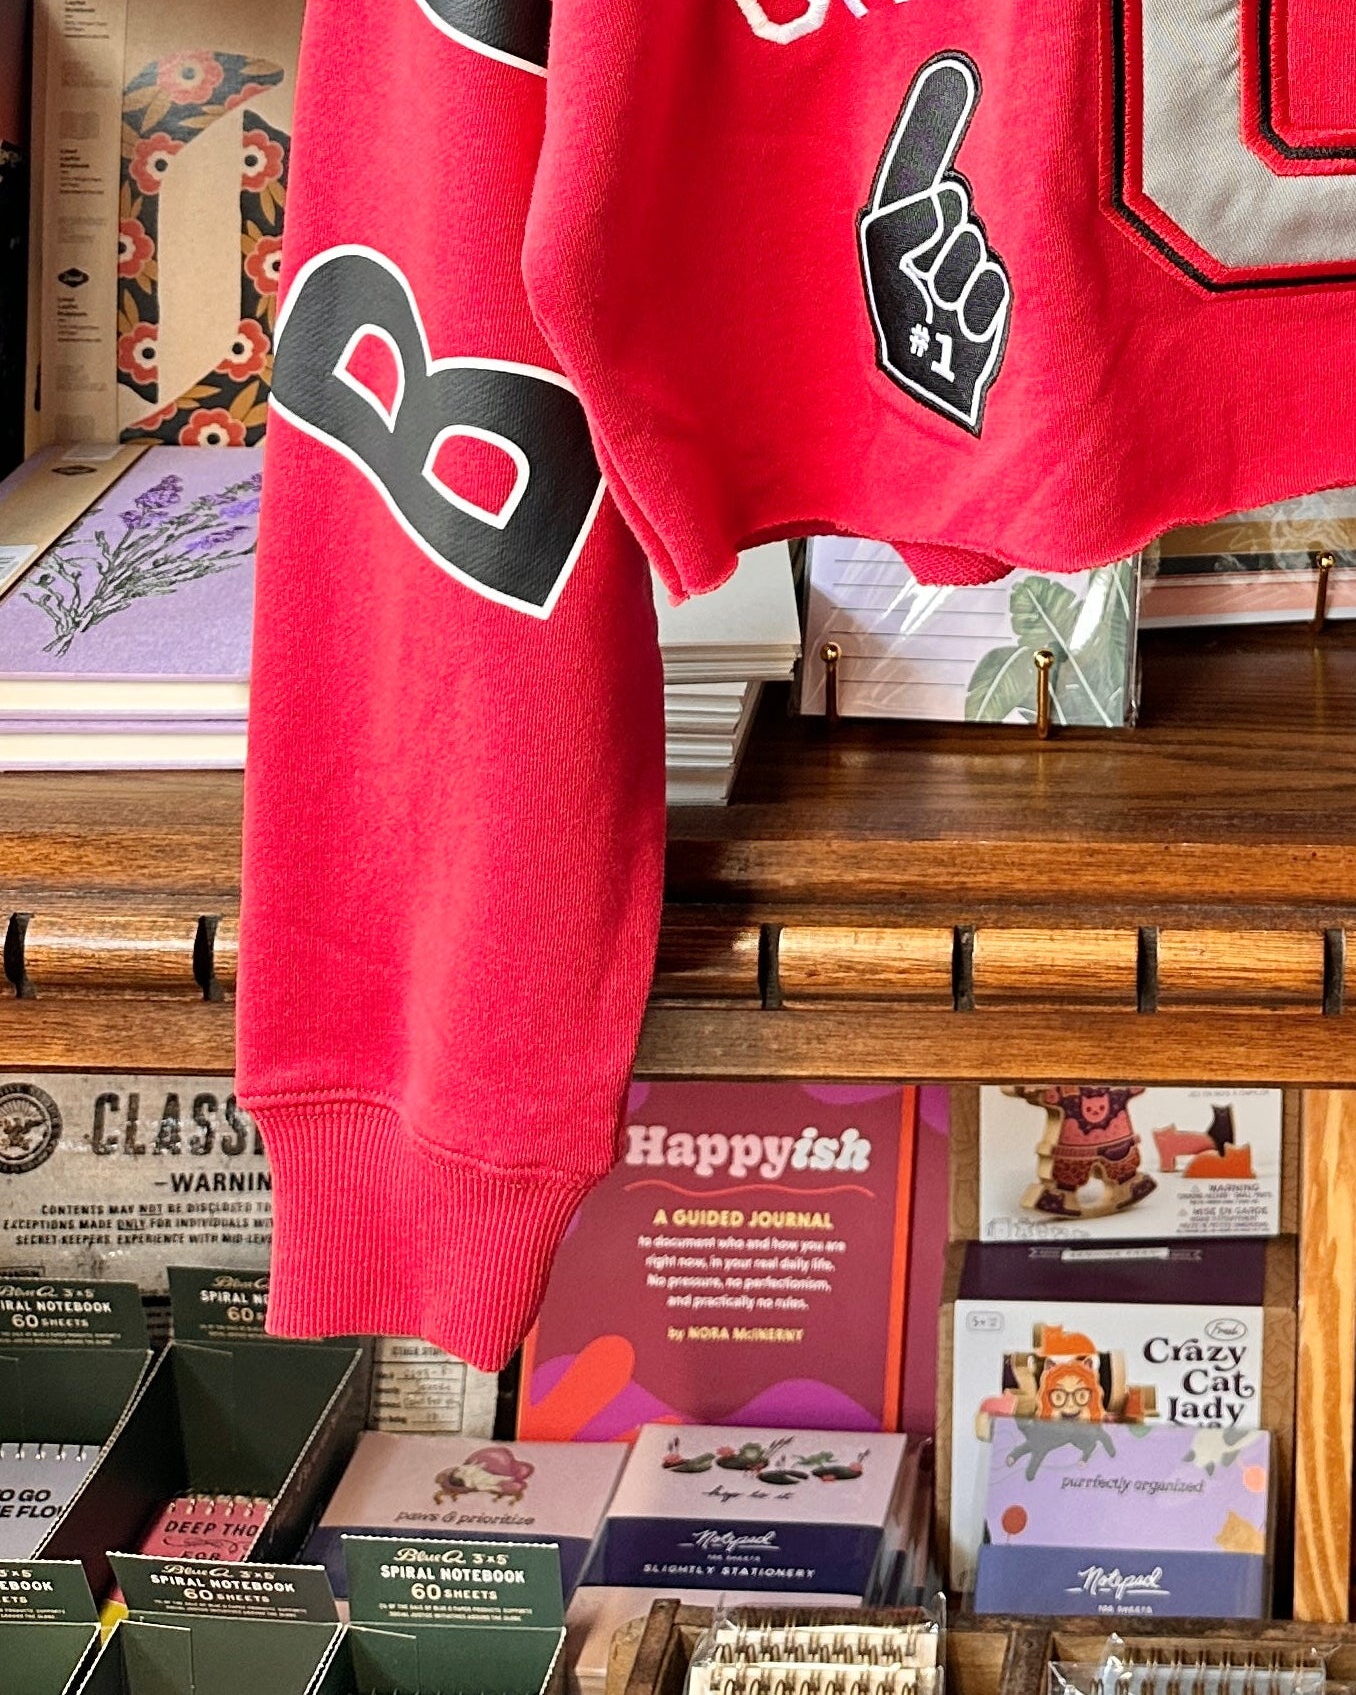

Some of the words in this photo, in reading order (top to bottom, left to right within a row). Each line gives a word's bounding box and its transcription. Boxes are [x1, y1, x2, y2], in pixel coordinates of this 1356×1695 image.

[909, 323, 955, 383] #1
[92, 1092, 266, 1156] CLASS
[625, 1124, 872, 1180] Happyish
[42, 1204, 104, 1215] CONTENTS
[3, 1219, 75, 1230] EXCEPTIONS
[79, 1219, 112, 1229] MADE
[652, 1209, 668, 1226] A
[672, 1209, 744, 1227] GUIDED
[748, 1211, 834, 1230] JOURNAL
[637, 1235, 652, 1247] to
[653, 1235, 716, 1248] document
[717, 1236, 745, 1251] who
[746, 1237, 771, 1251] and
[771, 1237, 799, 1252] how
[800, 1240, 824, 1254] you
[825, 1239, 847, 1252] are
[645, 1255, 676, 1271] right
[709, 1255, 723, 1268] in
[723, 1257, 752, 1272] your
[753, 1257, 779, 1270] real
[779, 1257, 811, 1274] daily
[646, 1273, 667, 1287] No
[725, 1276, 743, 1289] no
[200, 1290, 249, 1305] SPIRAL
[666, 1294, 692, 1307] and
[692, 1294, 754, 1311] practically
[756, 1297, 774, 1309] no
[0, 1299, 32, 1312] IRAL
[36, 1300, 112, 1314] NOTEBOOK
[227, 1306, 255, 1323] 60
[11, 1313, 39, 1328] 60
[41, 1318, 90, 1327] SHEETS
[666, 1326, 686, 1343] by
[687, 1326, 730, 1341] NORA
[1143, 1337, 1247, 1371] Crazy
[1183, 1368, 1254, 1398] Cat
[1167, 1396, 1245, 1425] Lady
[1060, 1474, 1131, 1494] purrfectly
[1133, 1478, 1205, 1495] organized
[19, 1489, 51, 1502] GO
[394, 1511, 440, 1522] paws
[456, 1512, 536, 1525] prioritize
[164, 1520, 217, 1535] DEEP
[222, 1523, 259, 1537] THO
[692, 1529, 777, 1552] Notepad
[380, 1564, 436, 1580] SPIRAL
[439, 1567, 526, 1584] NOTEBOOK
[642, 1563, 715, 1575] SLIGHTLY
[720, 1566, 815, 1578] STATIONERY
[0, 1580, 54, 1592] EBOOK
[150, 1574, 206, 1588] SPIRAL
[209, 1579, 296, 1593] NOTEBOOK
[410, 1582, 442, 1600] 60
[443, 1589, 498, 1600] SHEETS
[1077, 1565, 1164, 1600] Notepad
[183, 1588, 214, 1601] 60
[216, 1593, 270, 1603] SHEETS
